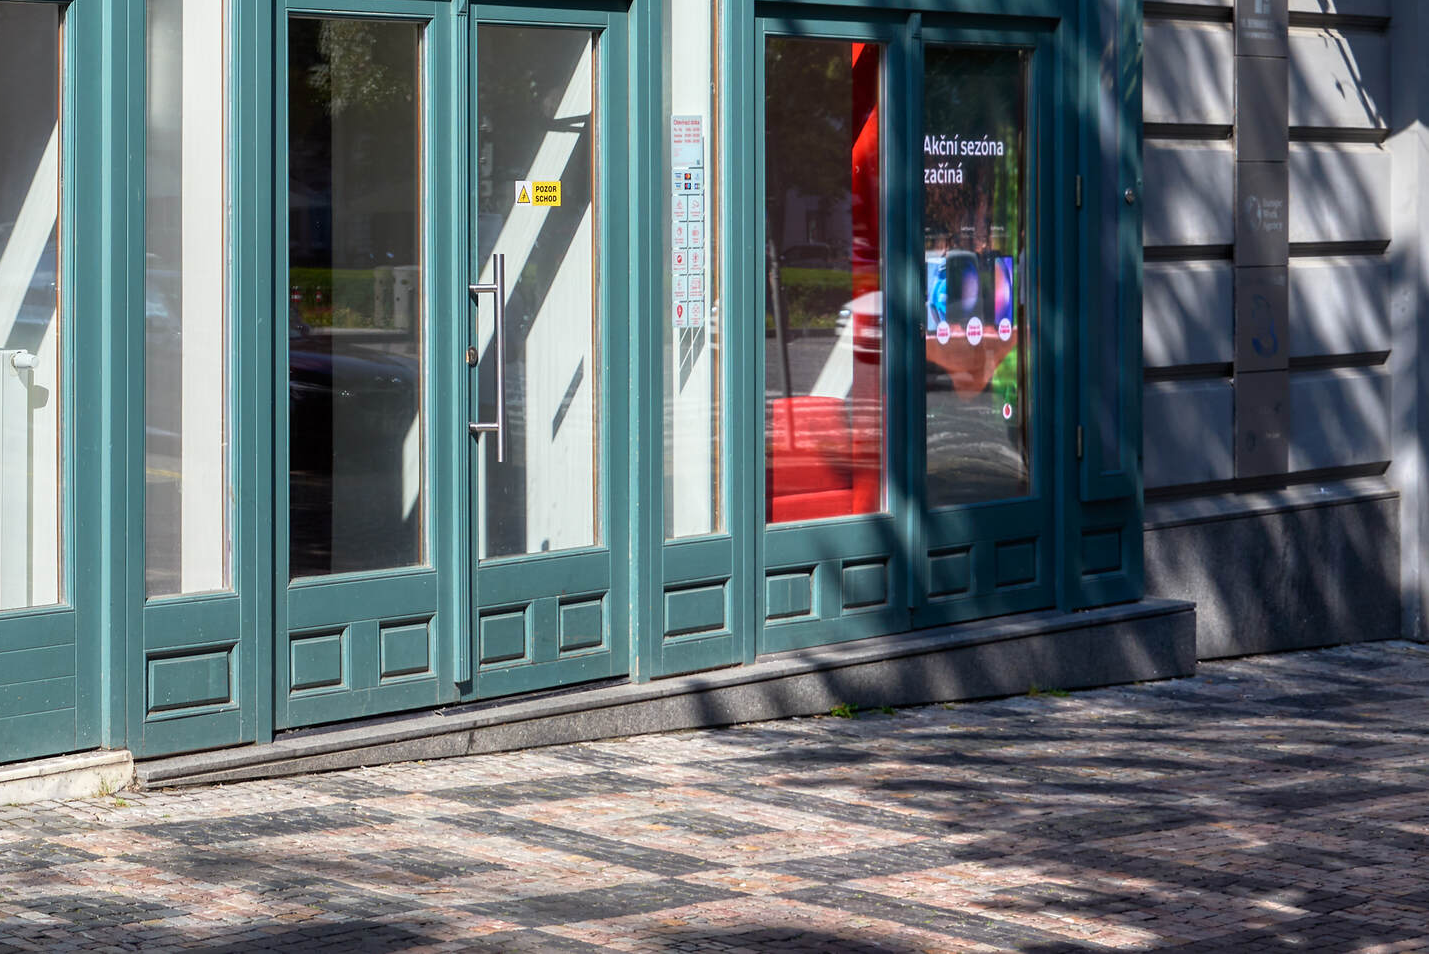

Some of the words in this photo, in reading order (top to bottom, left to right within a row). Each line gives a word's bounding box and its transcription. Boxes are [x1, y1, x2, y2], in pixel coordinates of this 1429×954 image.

[923, 135, 958, 156] Akční
[960, 135, 1004, 156] sezóna
[924, 163, 963, 184] začíná
